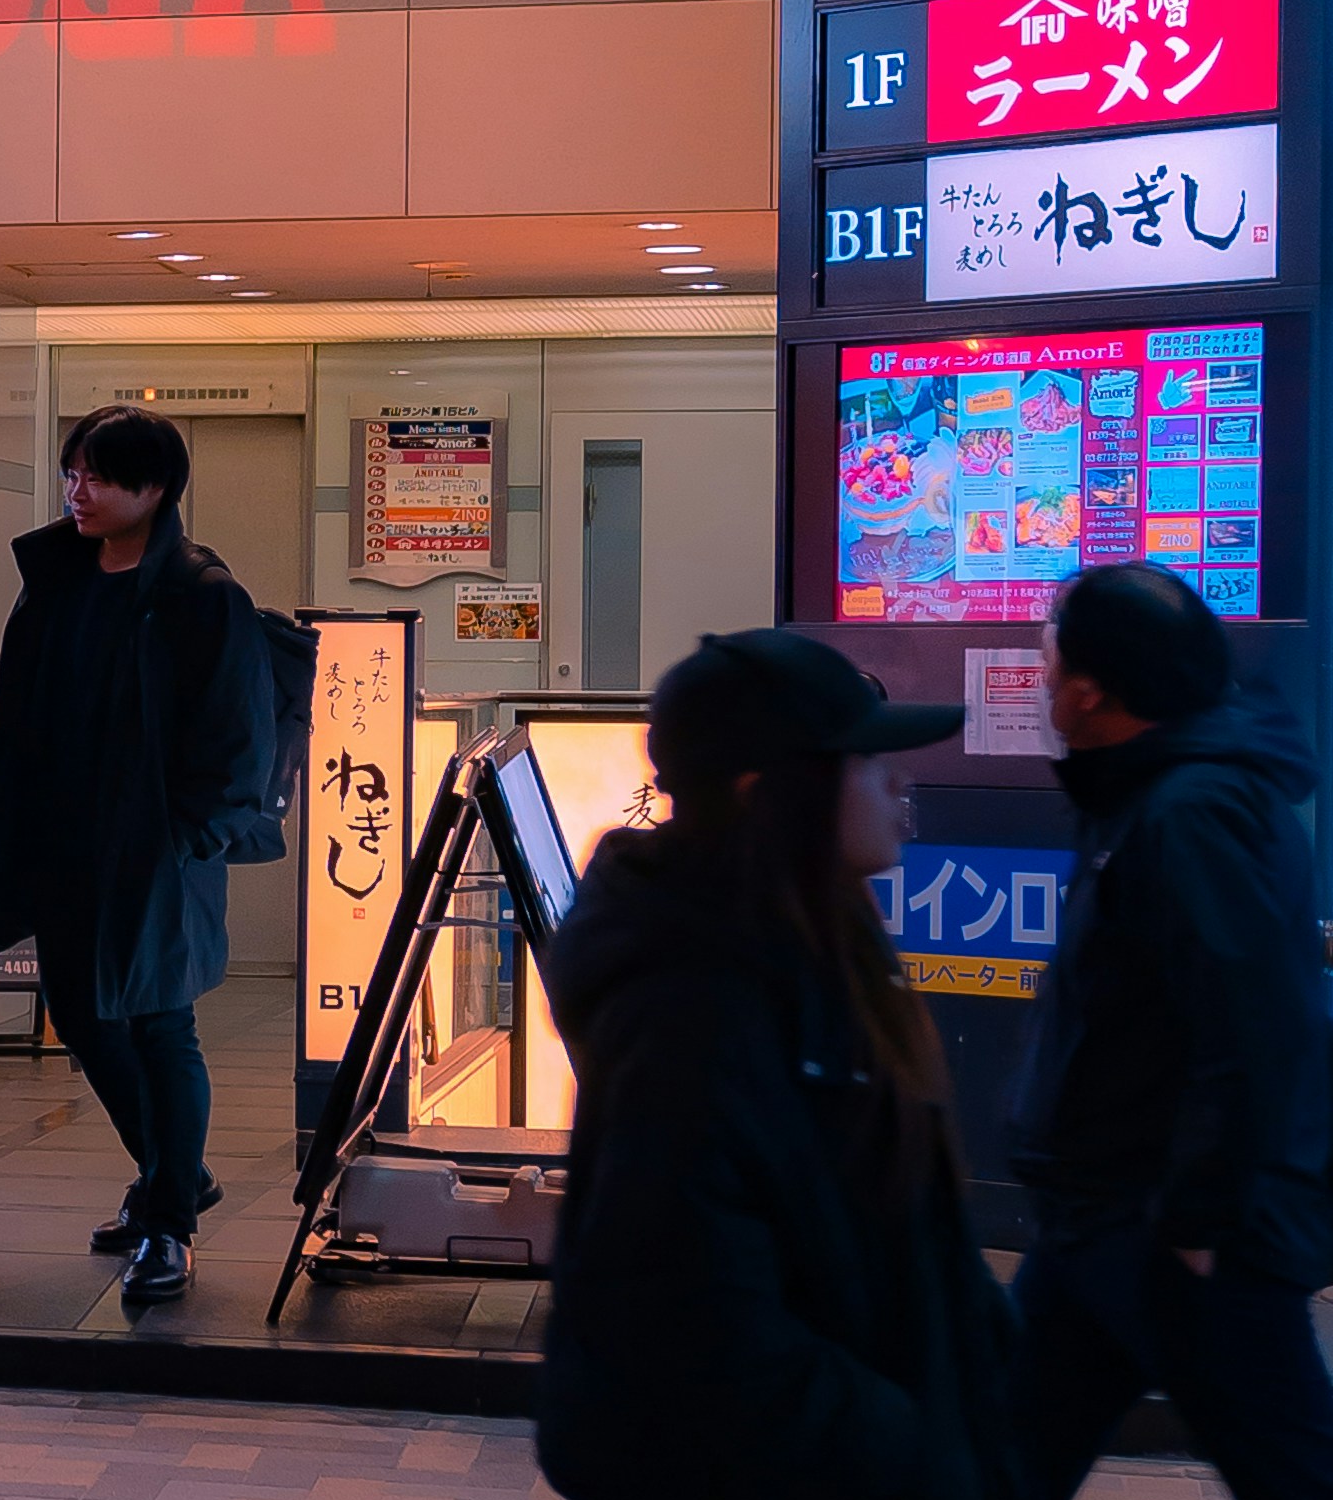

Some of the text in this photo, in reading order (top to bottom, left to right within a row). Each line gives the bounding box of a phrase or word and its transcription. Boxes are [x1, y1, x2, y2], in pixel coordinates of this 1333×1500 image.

[1020, 12, 1067, 47] IFU
[845, 51, 906, 111] 1F
[966, 35, 1225, 127] ラーメン
[938, 181, 1004, 214] 牛たん
[973, 212, 1024, 240] とろろ
[1033, 163, 1247, 268] ねぎし
[825, 205, 925, 262] B1F
[954, 246, 1009, 274] 麦めし
[1036, 341, 1124, 364] AmorE
[451, 509, 487, 521] ZINO
[1159, 533, 1192, 548] ZINO
[323, 660, 349, 722] 麦めし
[370, 645, 392, 705] 牛たん
[351, 674, 368, 737] とろろ
[320, 744, 392, 900] ねぎし
[868, 858, 1069, 946] コインロ
